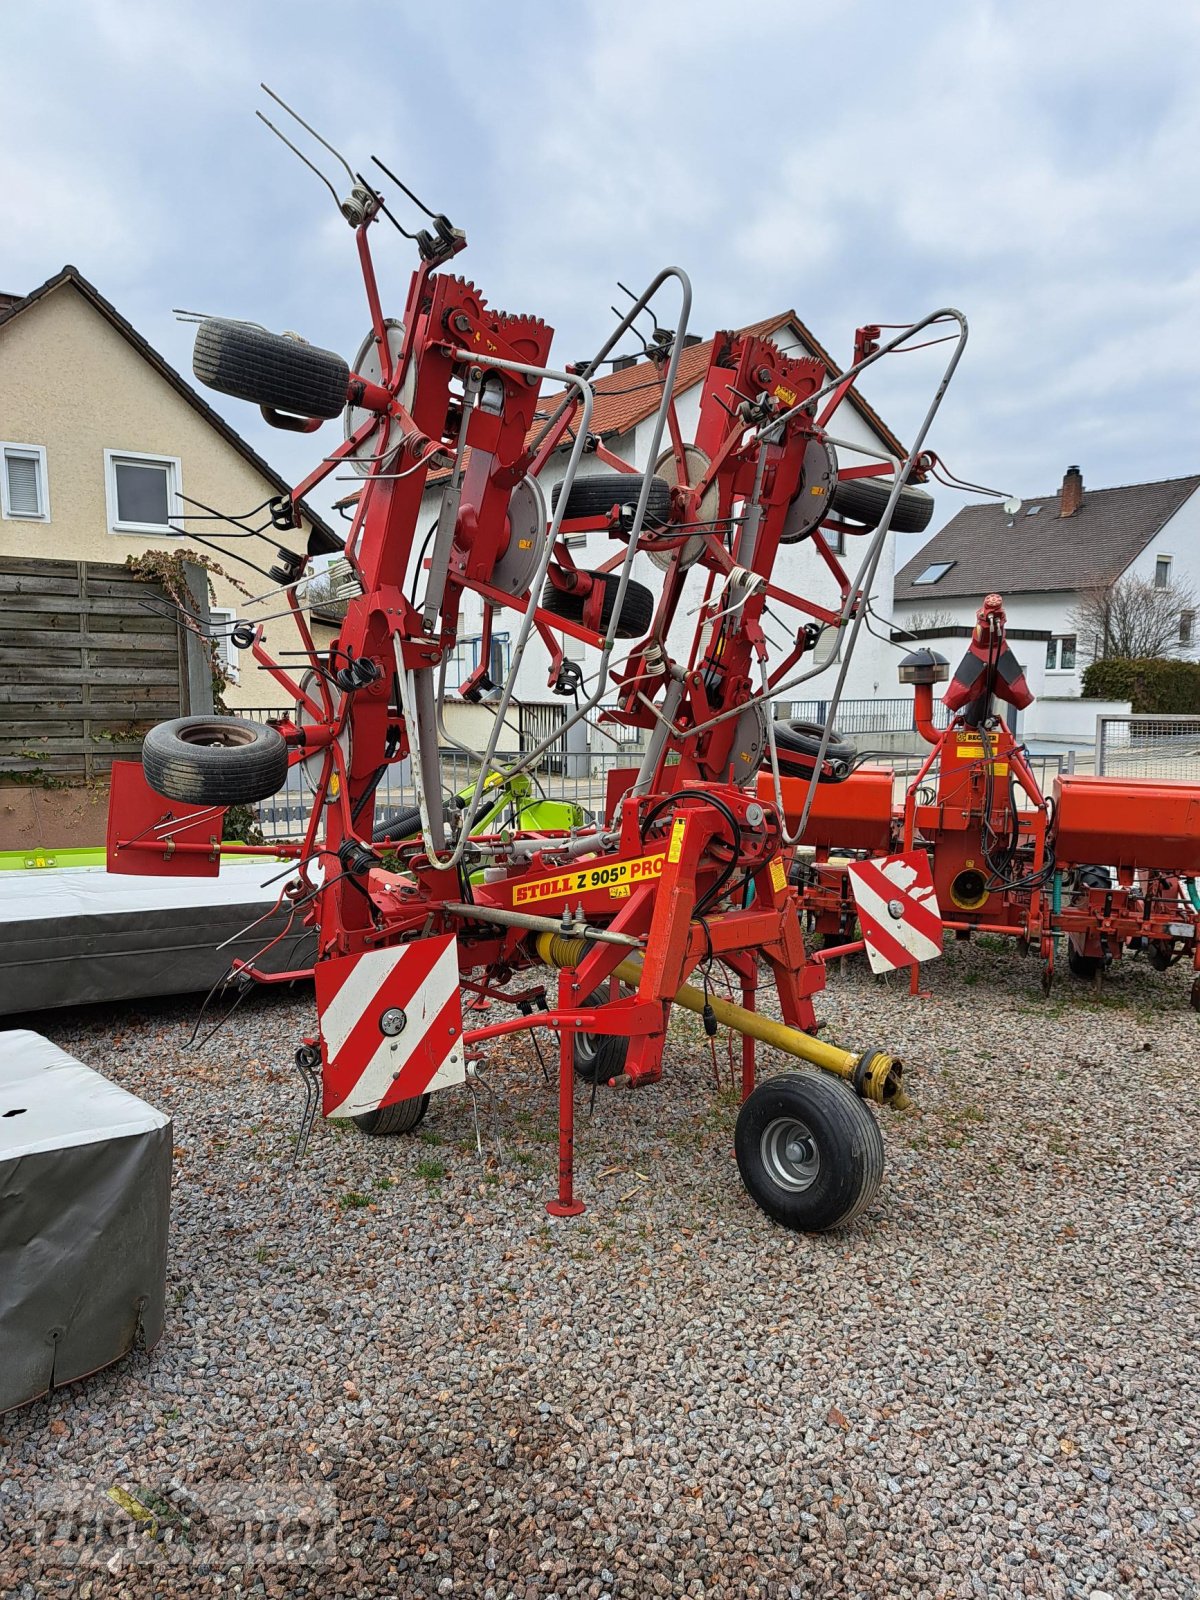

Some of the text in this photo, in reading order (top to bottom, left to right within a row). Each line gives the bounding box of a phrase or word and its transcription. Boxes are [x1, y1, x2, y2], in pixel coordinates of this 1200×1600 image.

[516, 878, 573, 902] STOLL
[577, 874, 587, 889] Z
[630, 857, 664, 879] PRO
